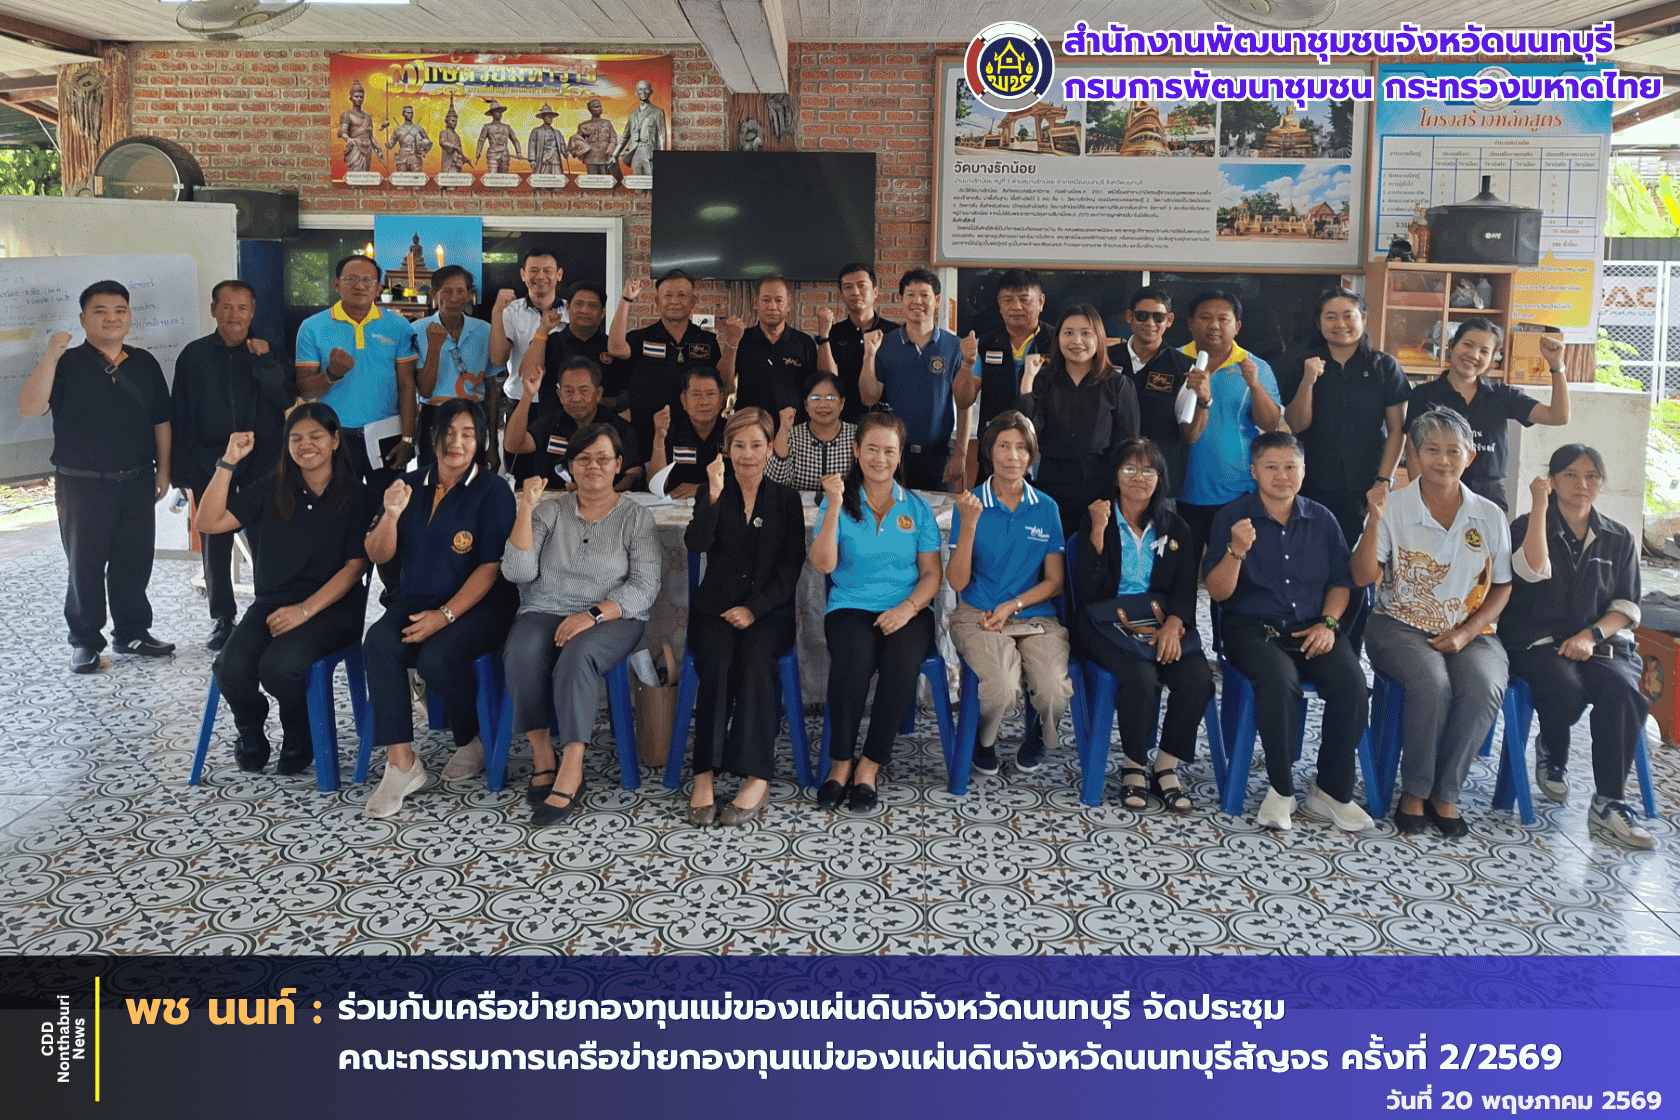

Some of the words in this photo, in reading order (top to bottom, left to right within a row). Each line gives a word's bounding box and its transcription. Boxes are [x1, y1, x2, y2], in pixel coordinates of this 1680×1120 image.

[1419, 106, 1563, 132] โครงสร้างหลักสูตร
[954, 160, 1037, 174] วัดบางรักน้อย
[1601, 286, 1656, 307] AC
